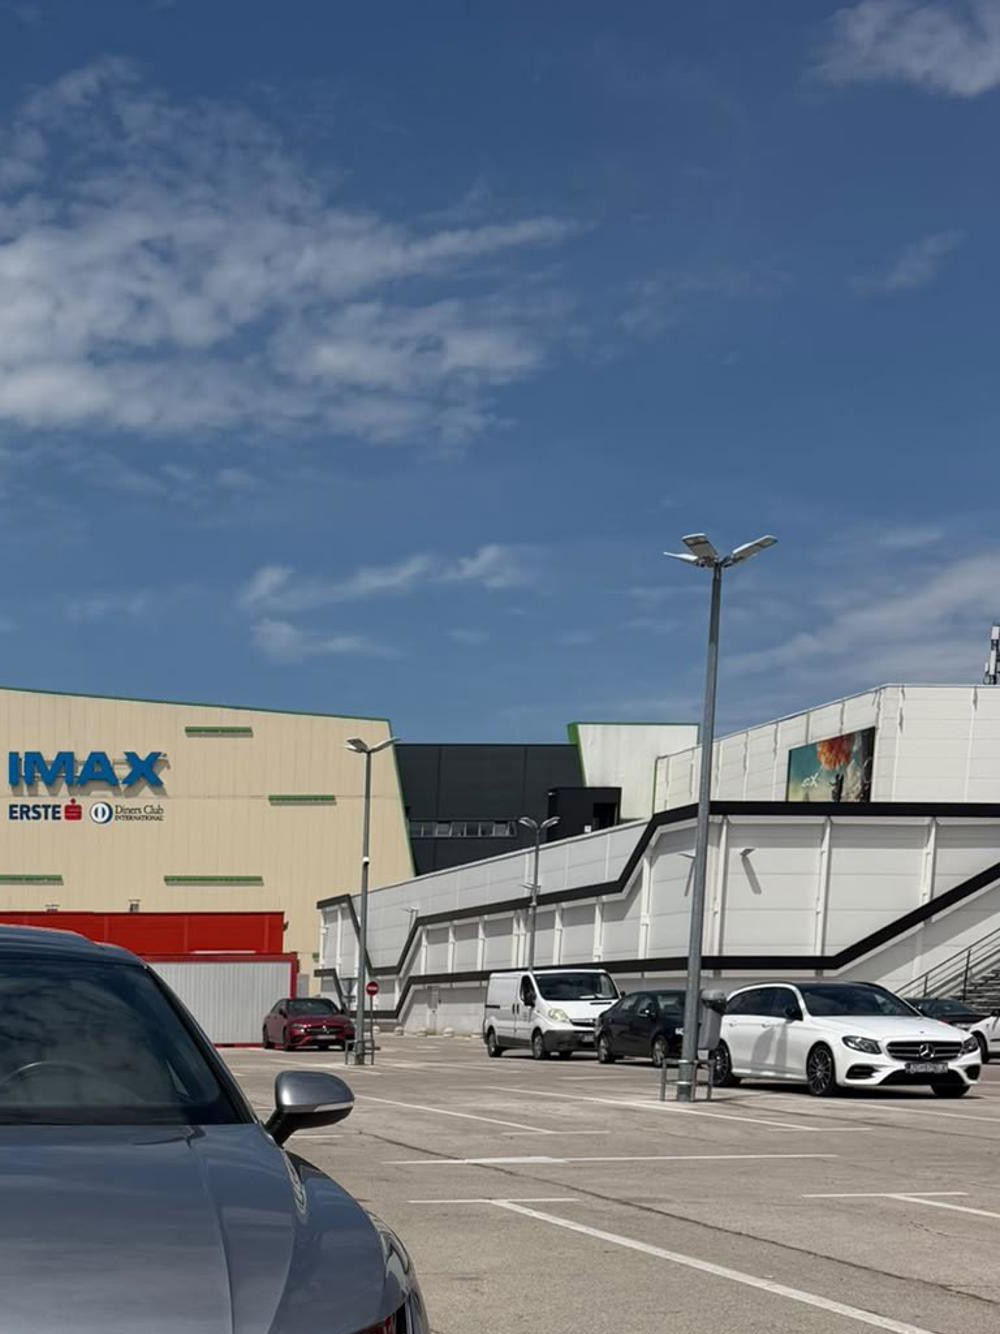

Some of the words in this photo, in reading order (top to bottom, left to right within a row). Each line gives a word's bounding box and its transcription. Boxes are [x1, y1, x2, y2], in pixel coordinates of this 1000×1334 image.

[8, 751, 164, 787] IMAX
[8, 804, 62, 821] ERSTE
[114, 804, 142, 815] Diners
[143, 804, 164, 815] Club
